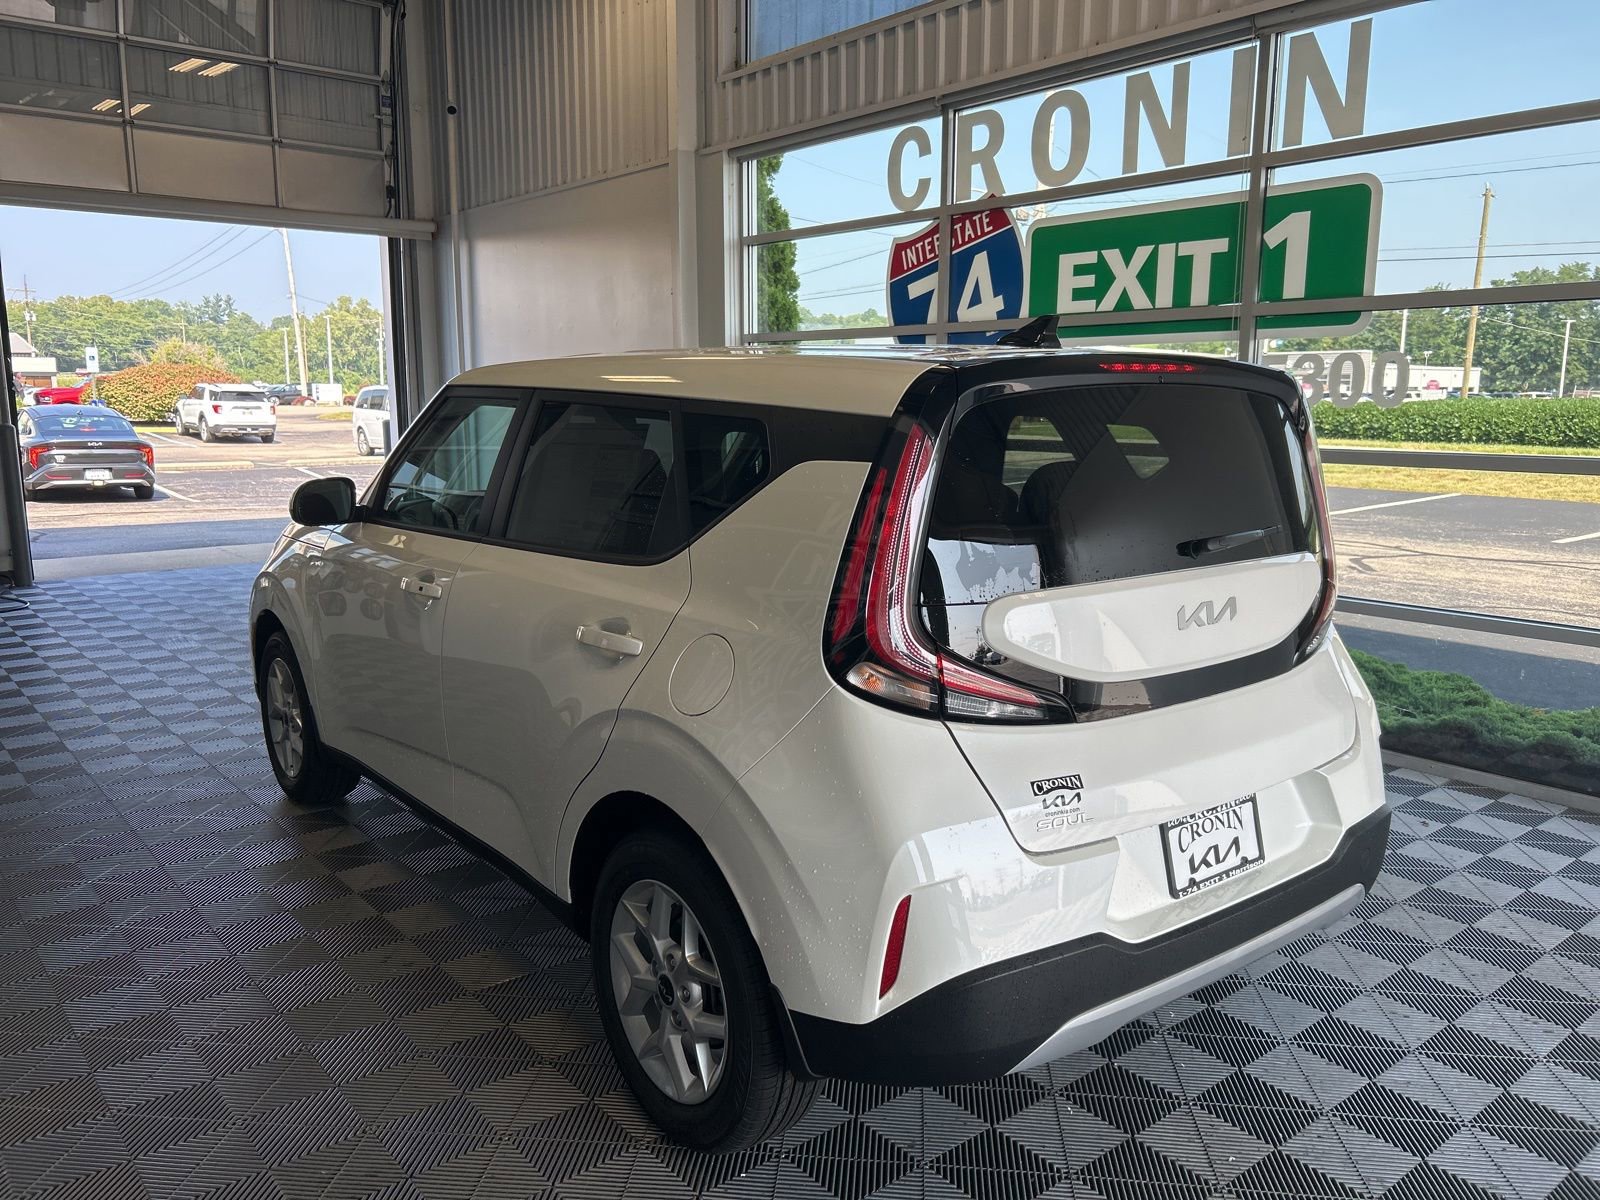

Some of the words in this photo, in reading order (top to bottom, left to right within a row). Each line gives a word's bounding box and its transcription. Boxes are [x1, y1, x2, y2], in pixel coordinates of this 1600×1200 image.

[887, 18, 1374, 212] CRONIN
[901, 210, 993, 271] INTERTATE
[1058, 237, 1229, 314] EXIT
[1263, 210, 1312, 299] 1
[907, 251, 1005, 344] 74
[1262, 351, 1410, 409] 300
[1176, 596, 1238, 631] KIA
[1033, 775, 1082, 796] CRONIN
[1042, 792, 1082, 810] KIA
[1036, 812, 1095, 832] SOUL
[1177, 806, 1245, 854] CRONIN
[1188, 835, 1241, 875] KIA
[1178, 885, 1198, 898] I-74
[1199, 876, 1221, 889] EXIT
[1221, 873, 1228, 881] 1
[1229, 859, 1265, 878] Harrison
